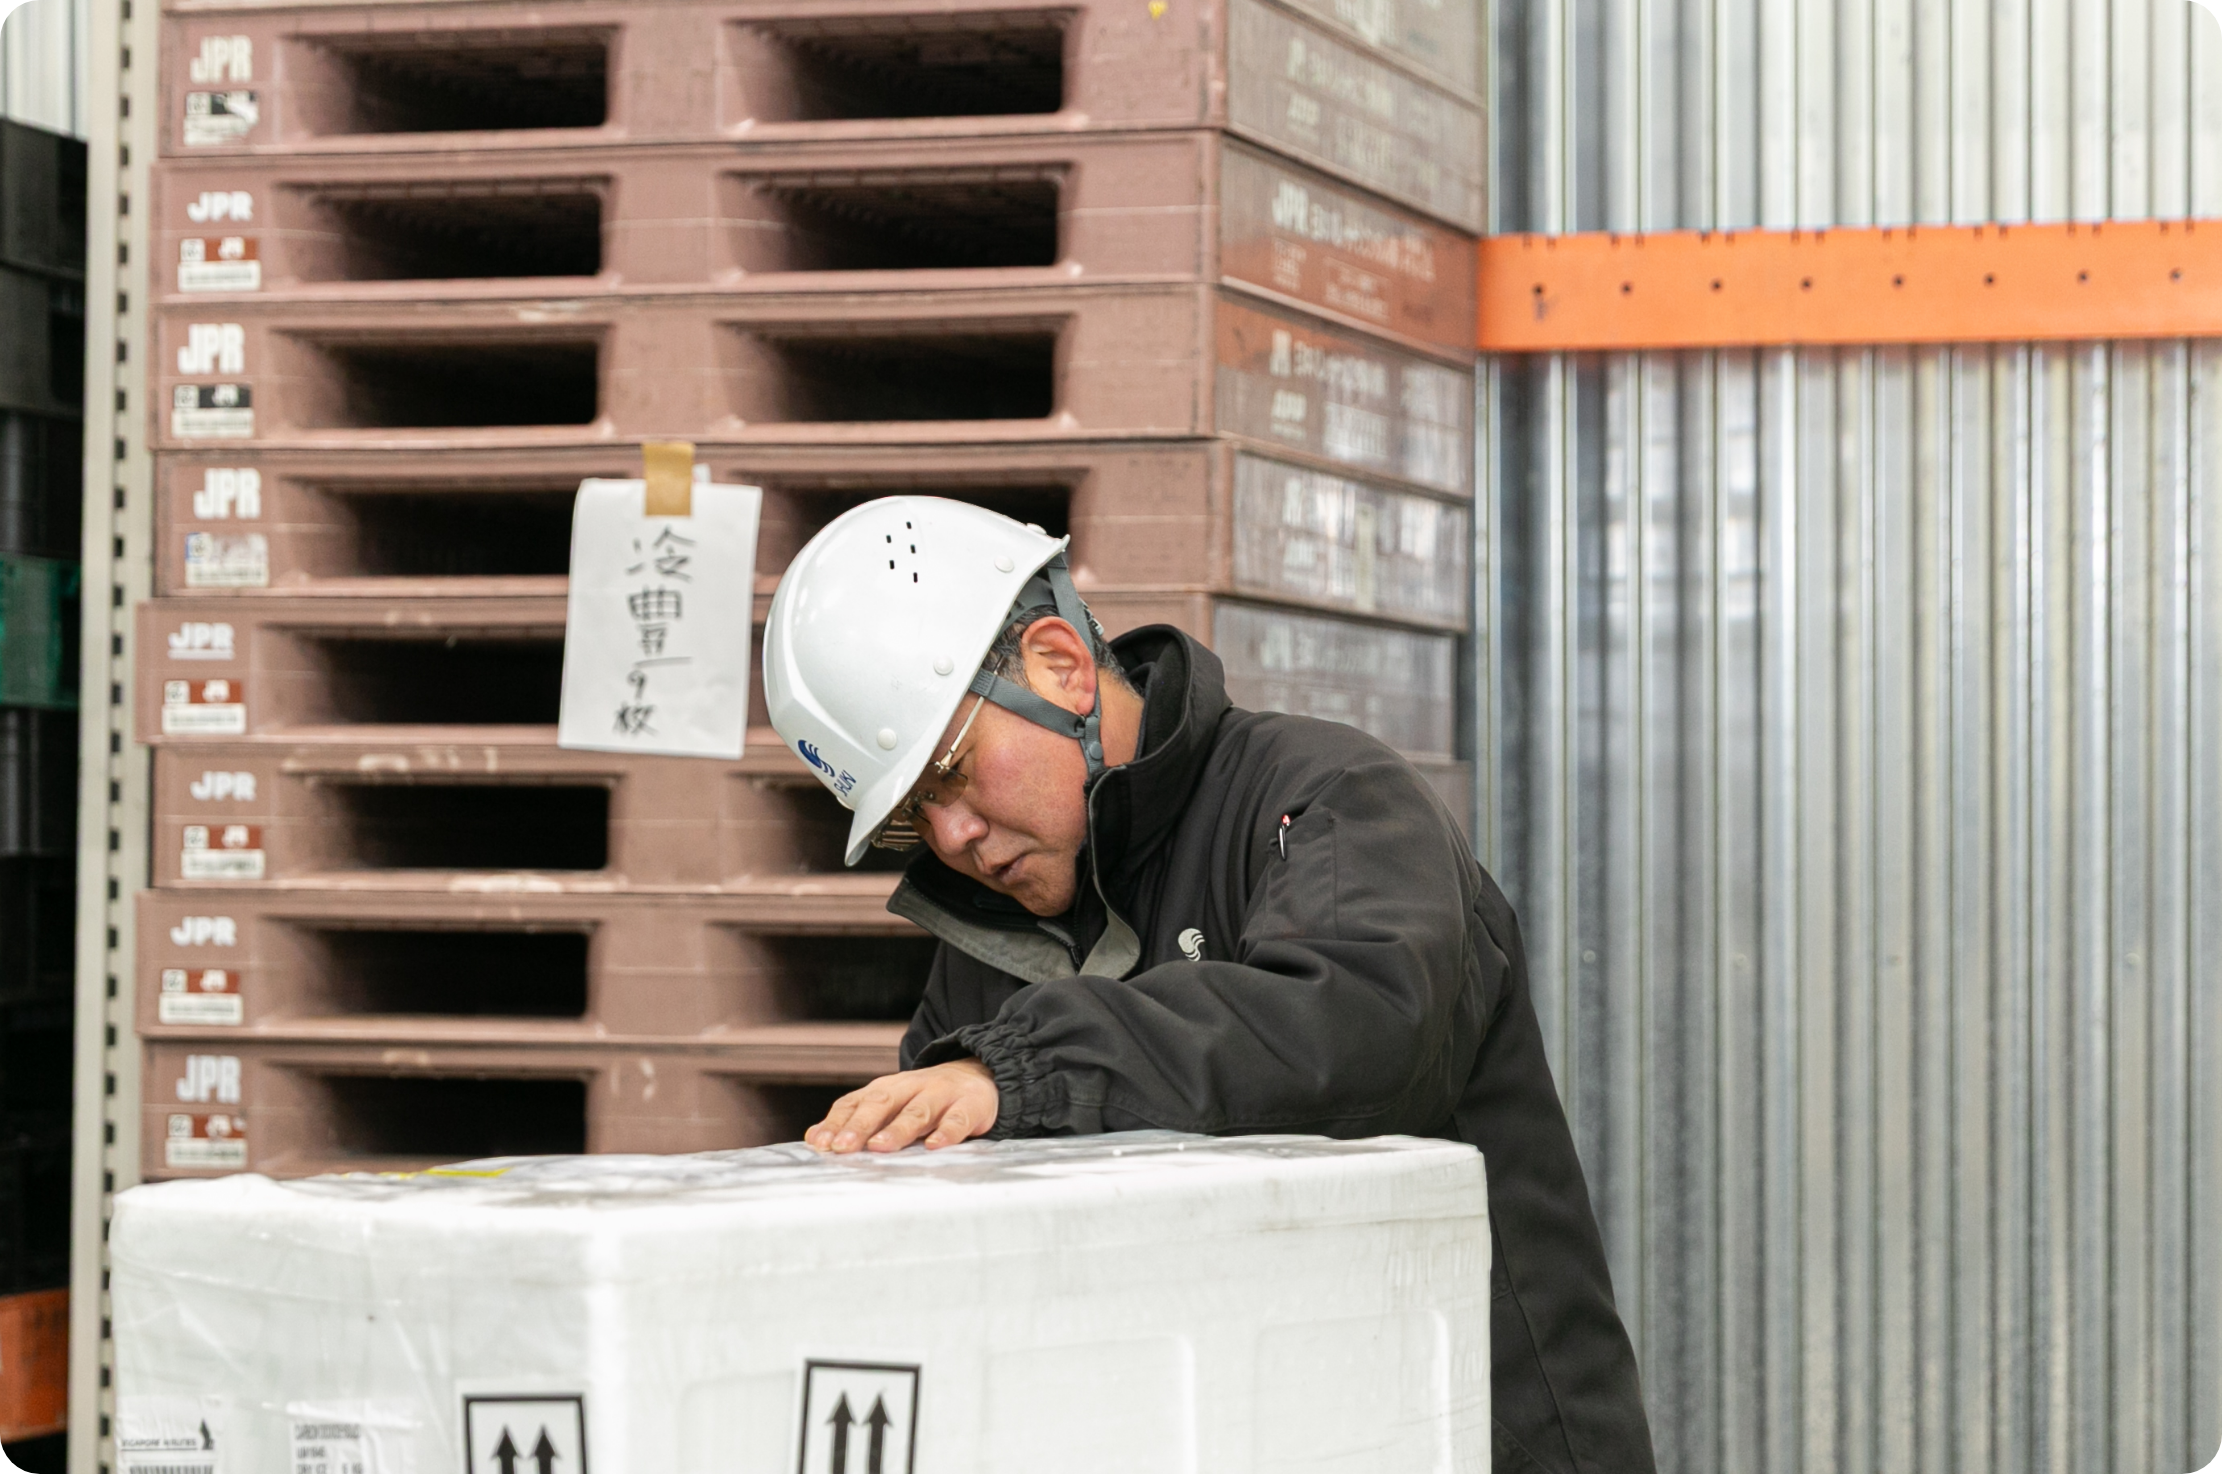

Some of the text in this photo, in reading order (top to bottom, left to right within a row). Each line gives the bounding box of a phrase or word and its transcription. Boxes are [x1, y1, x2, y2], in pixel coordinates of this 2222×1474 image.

[190, 35, 252, 84] JPR
[187, 191, 253, 222] JPR
[177, 323, 245, 375] JPR
[193, 468, 261, 519] JPR
[168, 622, 234, 650] JPR
[190, 771, 256, 801] JPR
[170, 916, 236, 946] JPR
[176, 1055, 241, 1104] JPR
